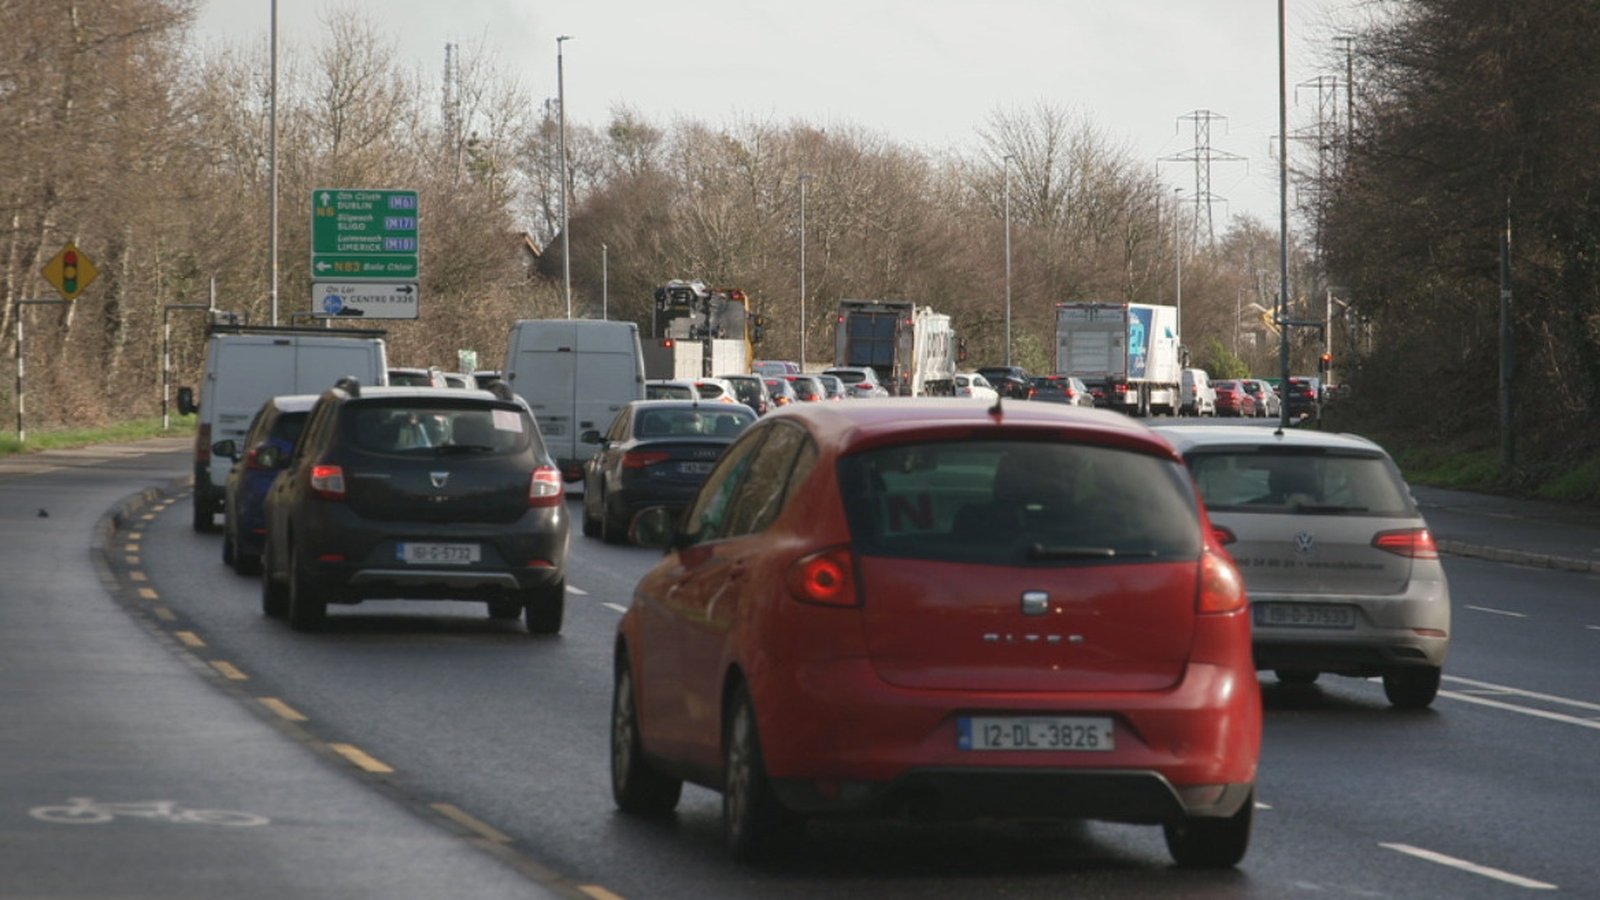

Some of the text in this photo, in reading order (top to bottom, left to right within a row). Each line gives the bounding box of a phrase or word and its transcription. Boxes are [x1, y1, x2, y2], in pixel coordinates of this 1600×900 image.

[338, 202, 373, 210] DUBLIN
[338, 223, 366, 231] SLIGO
[337, 243, 382, 252] LIMERICK
[335, 262, 361, 272] N83
[350, 296, 387, 304] CENTRE
[888, 494, 933, 531] N
[983, 724, 1100, 747] 12-DL-3826
